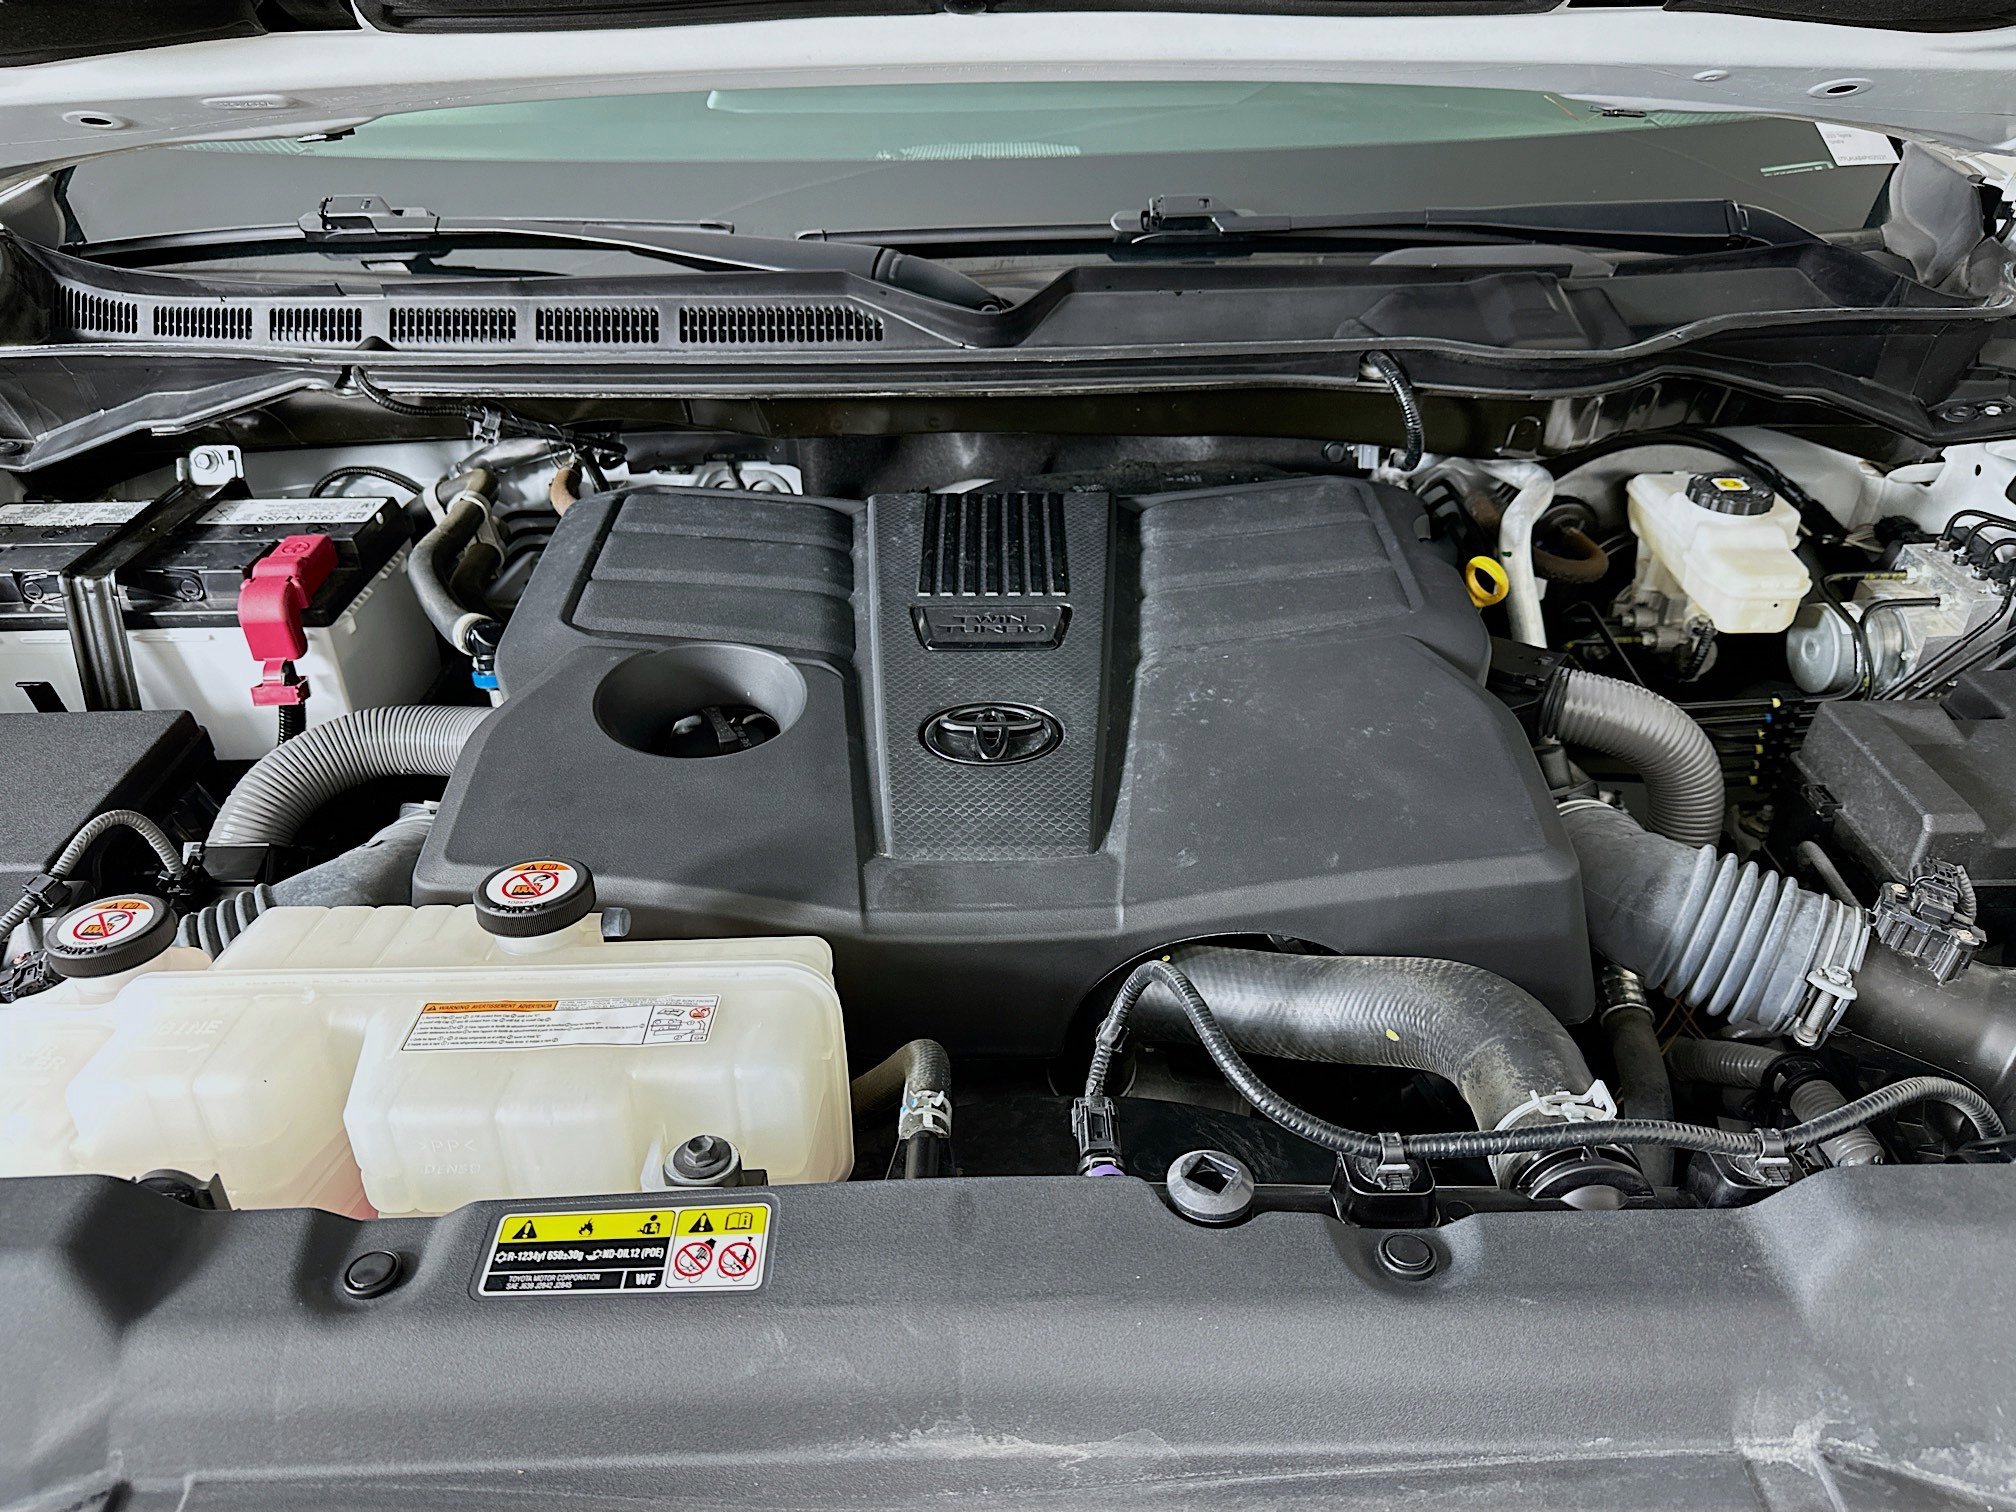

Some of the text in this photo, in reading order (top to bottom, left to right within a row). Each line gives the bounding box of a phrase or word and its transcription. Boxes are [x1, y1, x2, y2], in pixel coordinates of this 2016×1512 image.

[952, 614, 1027, 624] TWIN
[937, 624, 1047, 634] TURBO
[507, 1251, 547, 1262] R-1234yf
[641, 1247, 664, 1259] (POE)
[556, 1273, 601, 1281] CORPORATION
[635, 1273, 656, 1285] WF
